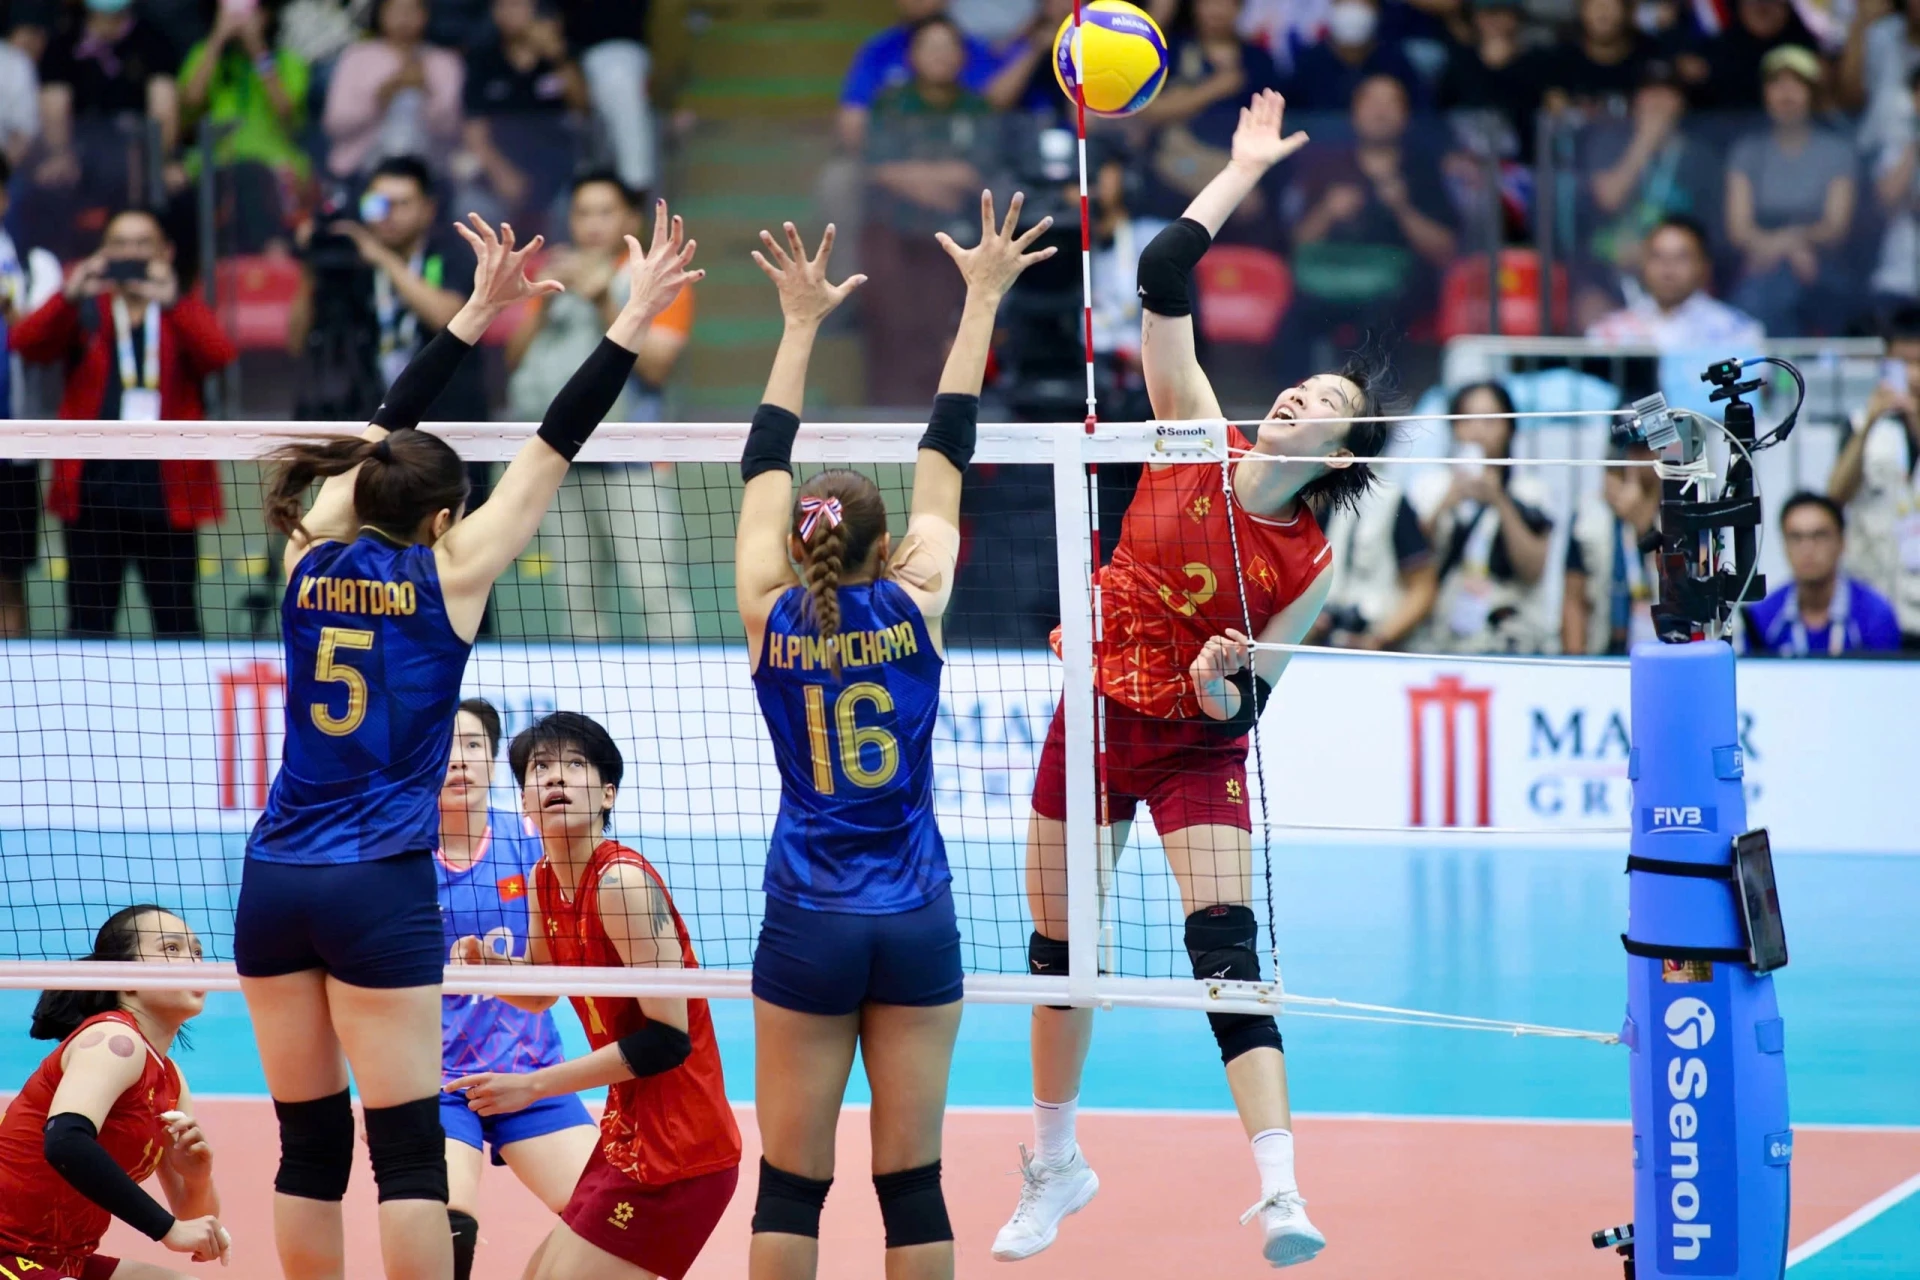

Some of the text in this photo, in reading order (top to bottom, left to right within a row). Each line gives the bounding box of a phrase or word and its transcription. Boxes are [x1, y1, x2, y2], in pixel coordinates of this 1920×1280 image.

[1167, 427, 1207, 436] Senoh
[297, 575, 416, 615] K.THATDAO
[310, 627, 374, 736] 5
[803, 682, 899, 795] 16
[1654, 806, 1702, 825] FIVB
[1668, 1057, 1711, 1261] Senoh
